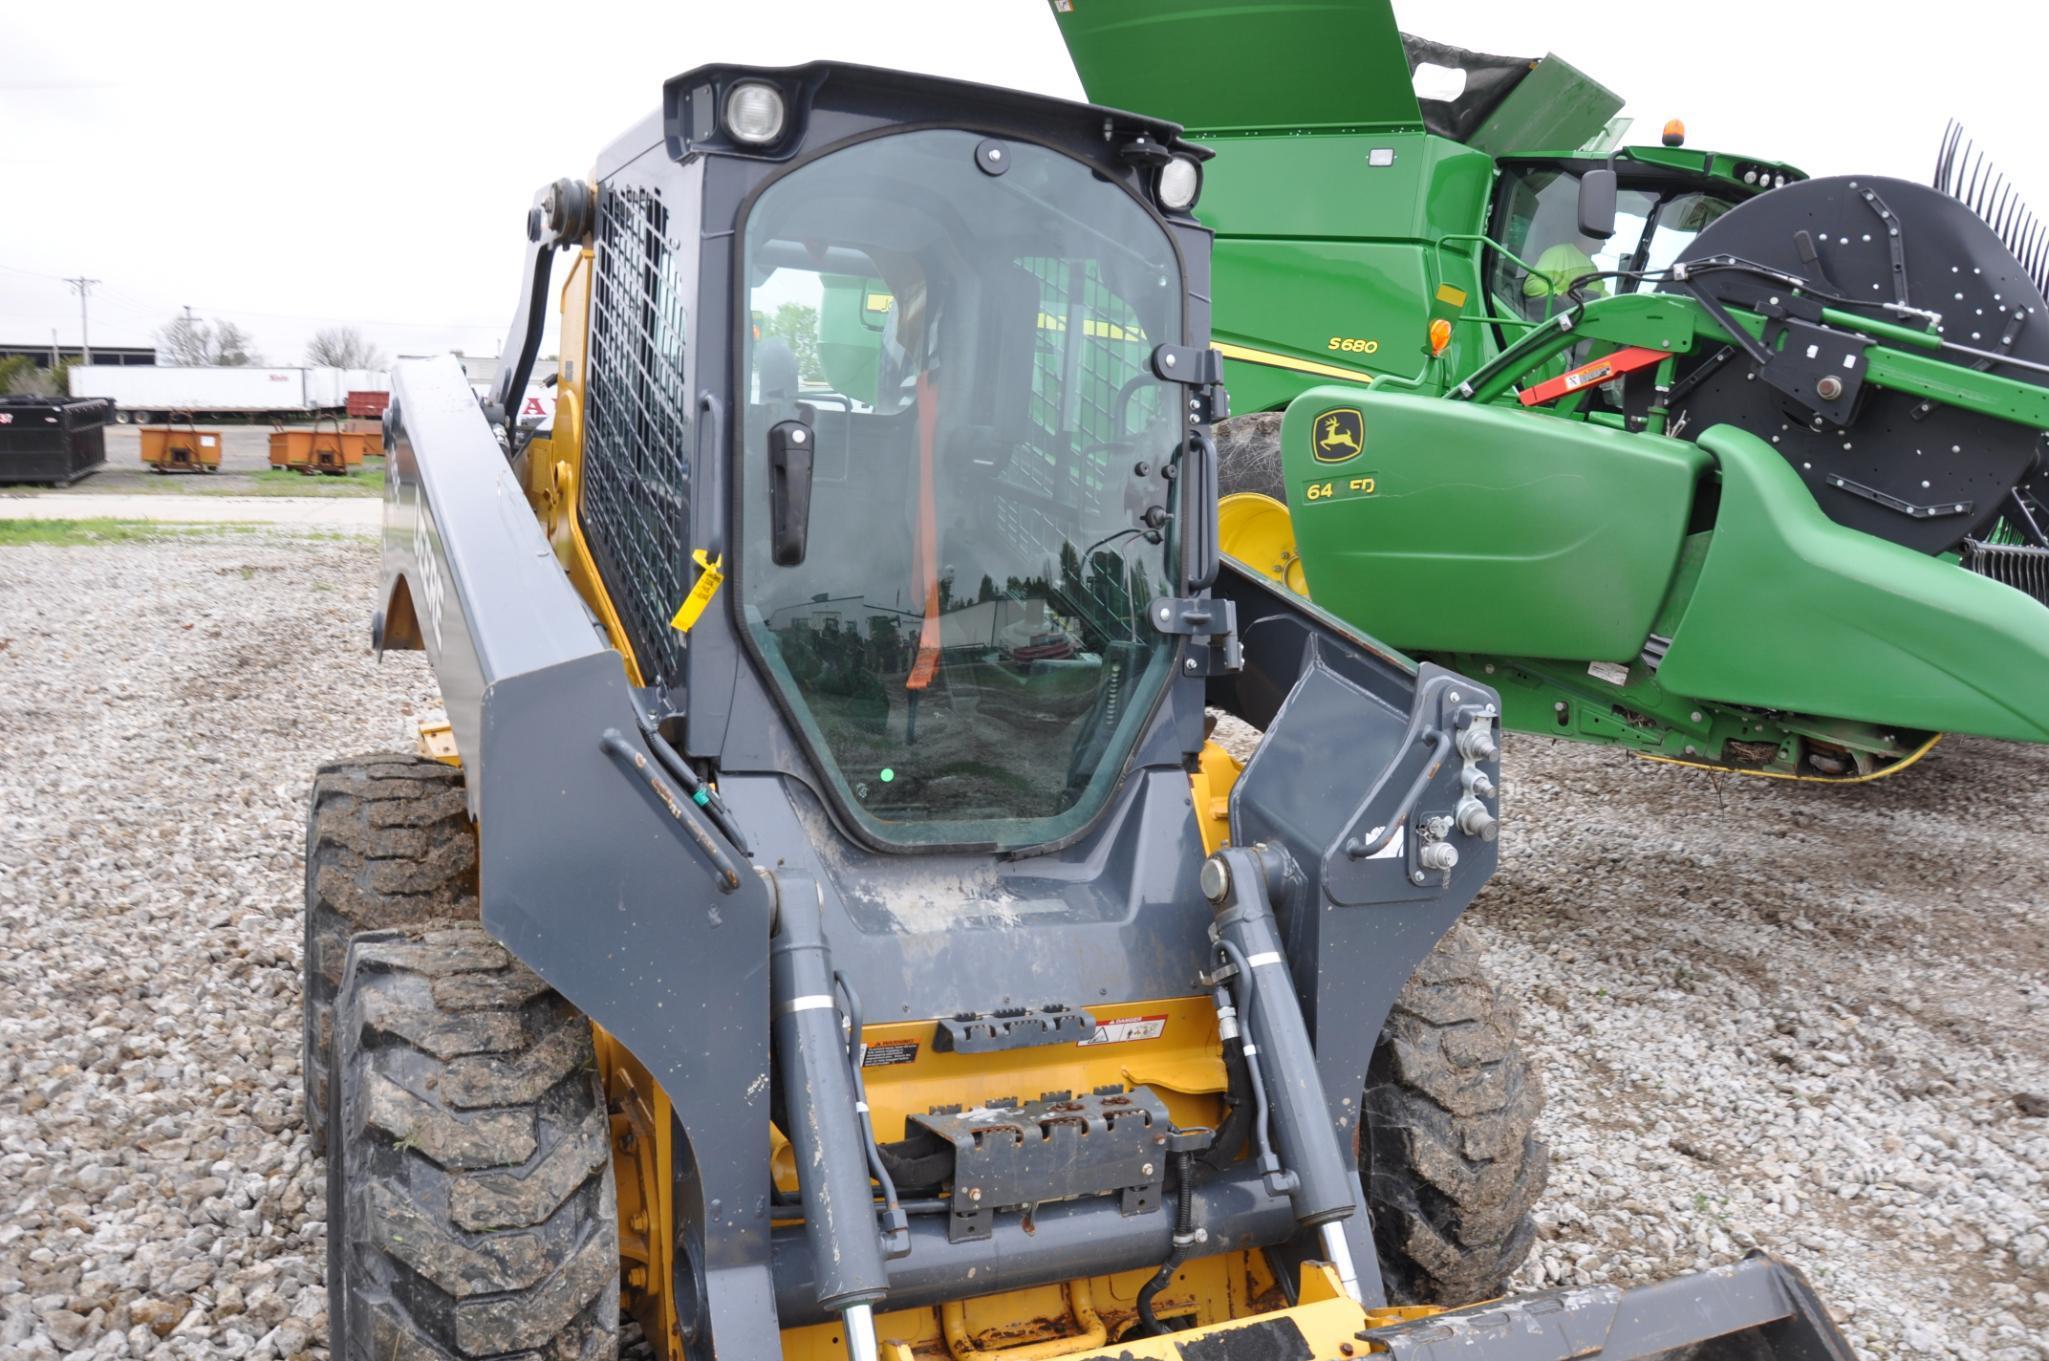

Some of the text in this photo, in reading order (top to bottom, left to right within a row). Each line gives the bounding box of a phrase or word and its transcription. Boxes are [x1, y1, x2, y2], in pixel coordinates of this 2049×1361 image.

[1327, 336, 1379, 354] S680
[522, 397, 550, 415] A
[413, 482, 445, 652] DEERE
